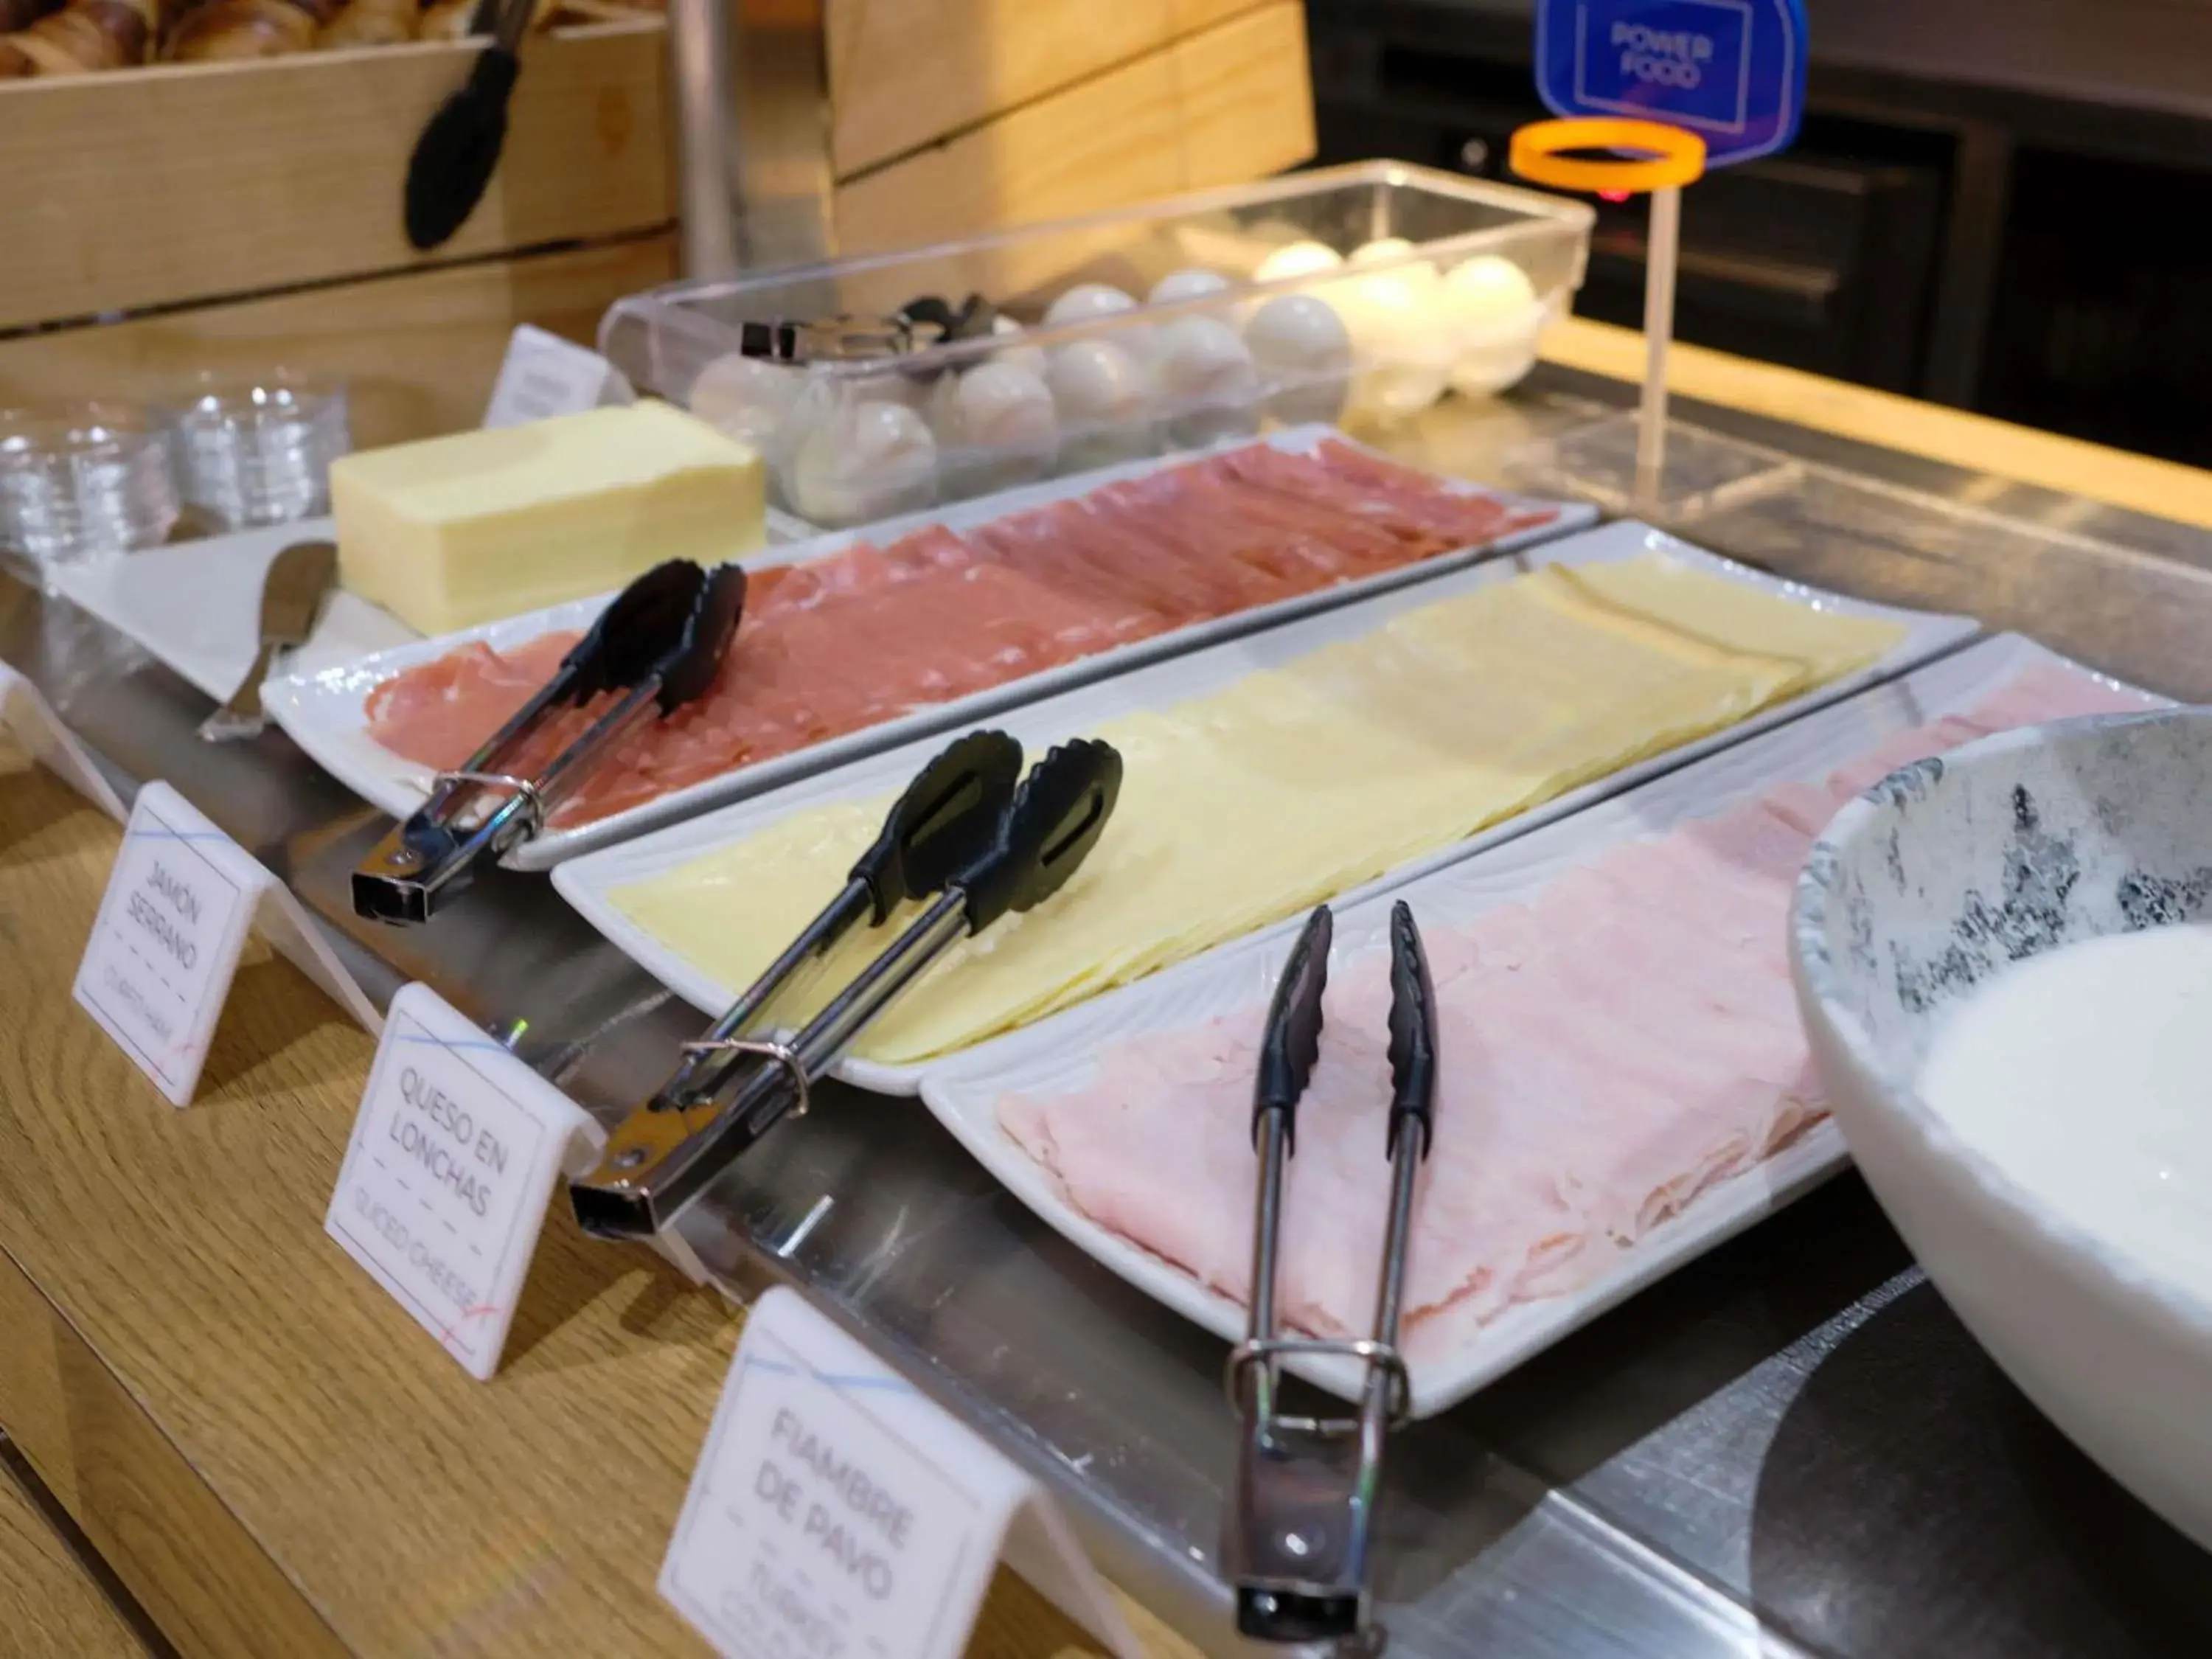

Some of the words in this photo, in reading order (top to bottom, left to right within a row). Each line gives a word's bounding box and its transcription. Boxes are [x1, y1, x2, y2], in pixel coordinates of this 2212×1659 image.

[1611, 20, 1714, 62] POWER
[1621, 50, 1702, 89] FOOD
[127, 889, 197, 970] SERRANO
[389, 1109, 492, 1218] LONCHAS
[399, 1065, 473, 1147] QUESO
[474, 1127, 509, 1175] EN
[408, 1240, 478, 1310] CHEESE
[771, 1406, 914, 1549] FIAMBRE
[754, 1458, 803, 1523] DE
[804, 1503, 894, 1601] PAVO
